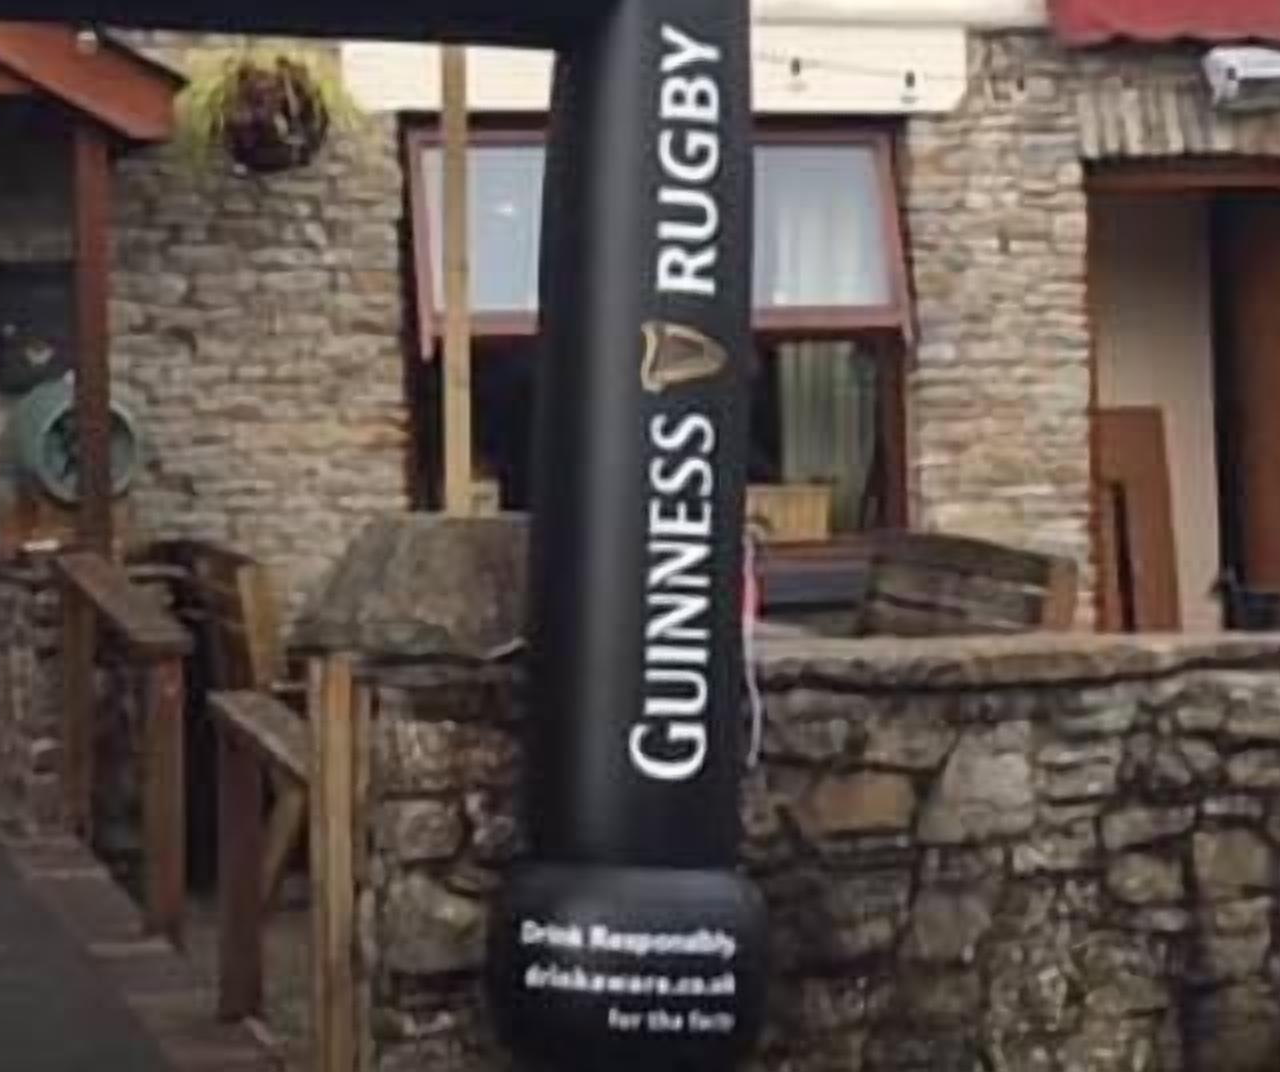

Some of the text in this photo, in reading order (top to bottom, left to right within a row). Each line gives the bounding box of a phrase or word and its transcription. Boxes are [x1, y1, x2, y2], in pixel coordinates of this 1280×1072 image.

[628, 24, 721, 781] GUINNESS RUGBY
[521, 918, 582, 948] Drink
